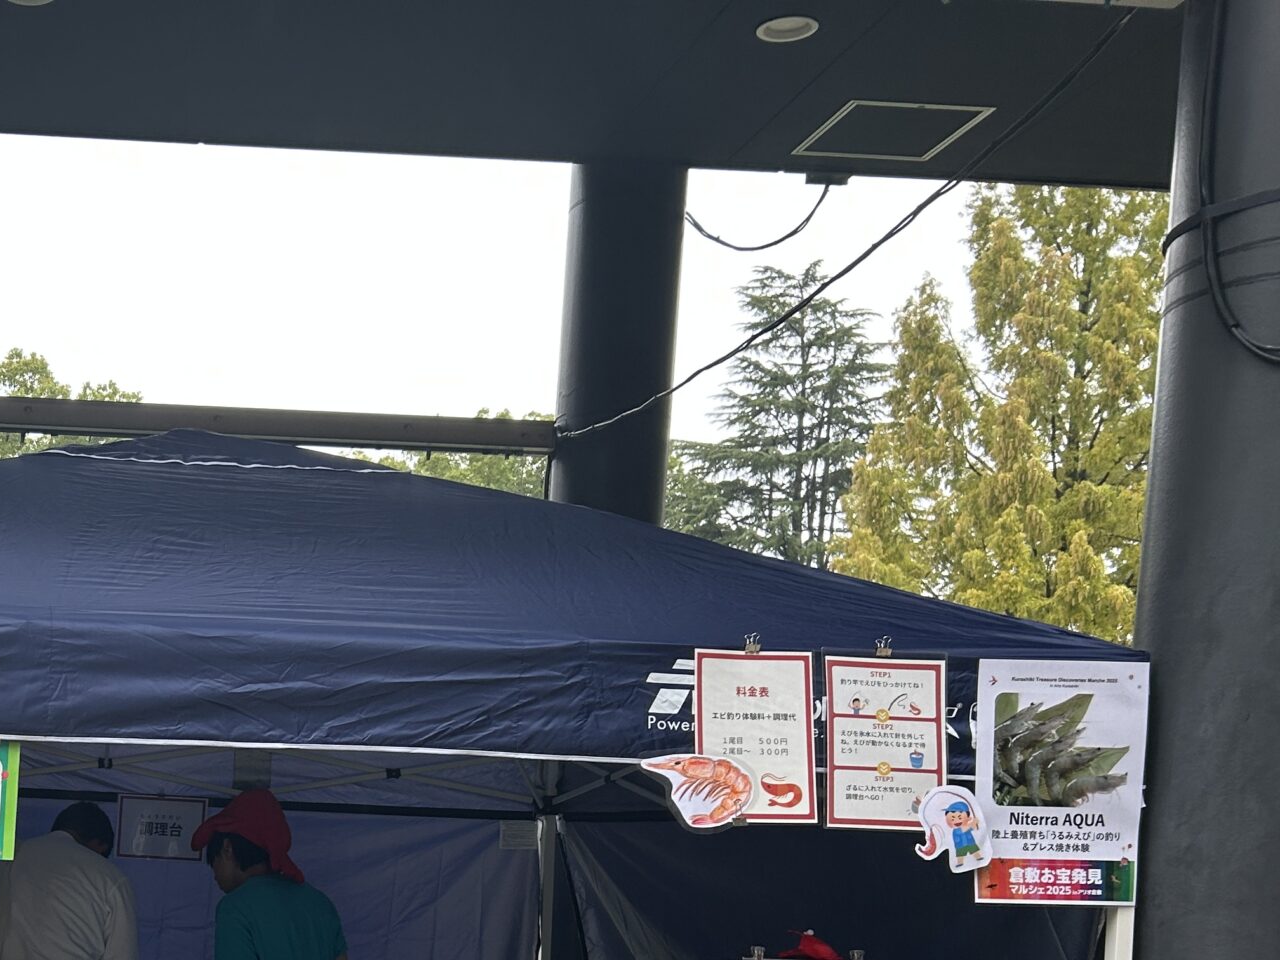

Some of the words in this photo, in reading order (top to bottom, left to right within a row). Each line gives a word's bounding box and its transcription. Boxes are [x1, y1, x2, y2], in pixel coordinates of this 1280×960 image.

[736, 686, 769, 697] 料金表
[1009, 812, 1058, 827] Niterra
[1063, 813, 1105, 829] AQUA
[1008, 867, 1102, 885] 倉敷お宝発見
